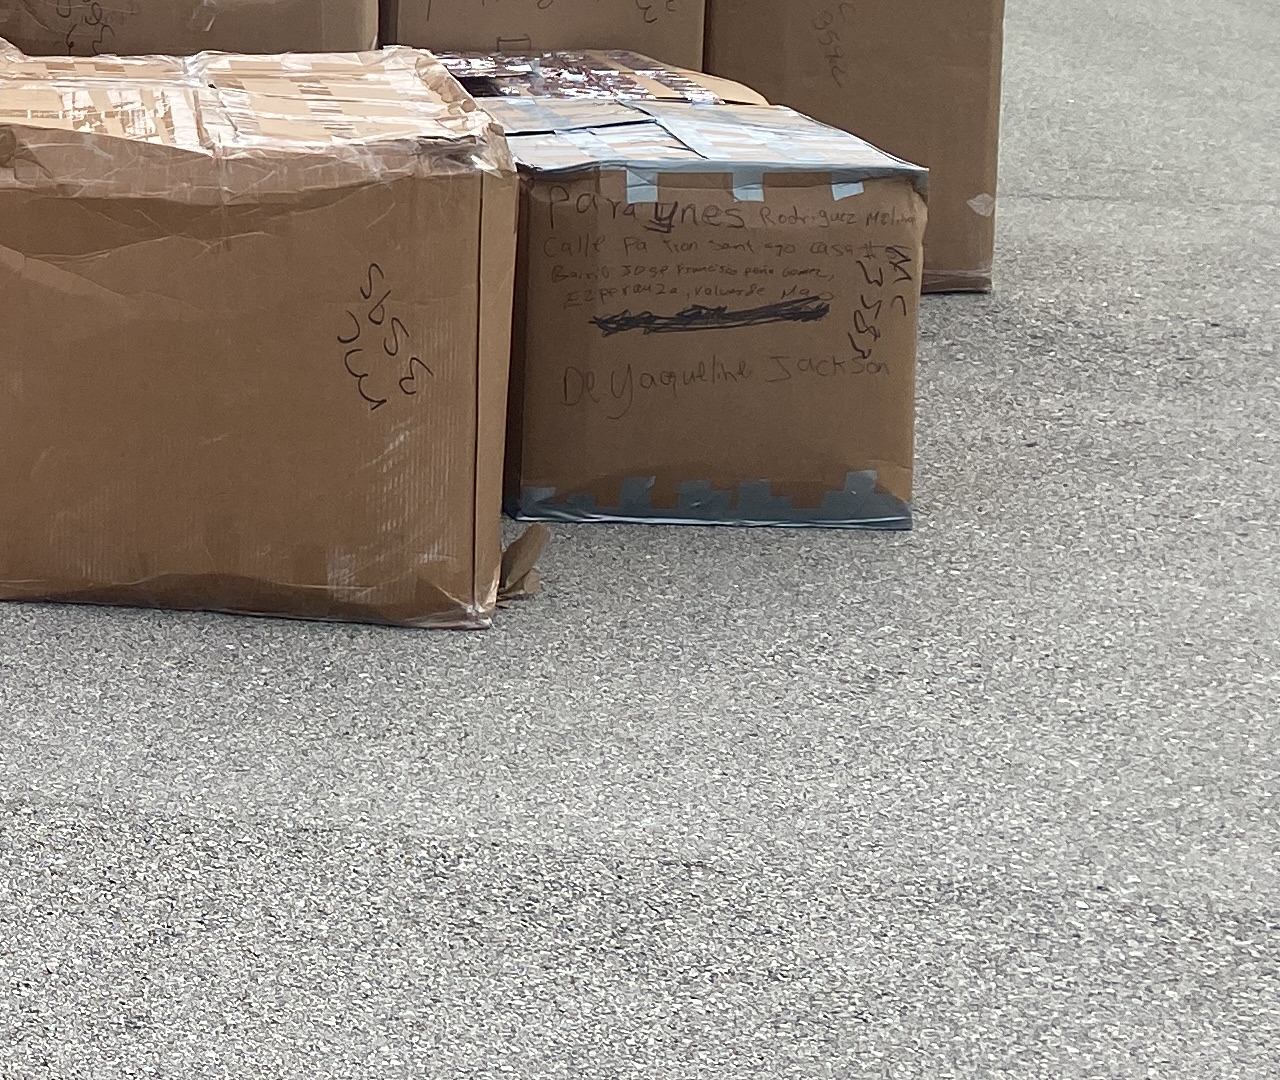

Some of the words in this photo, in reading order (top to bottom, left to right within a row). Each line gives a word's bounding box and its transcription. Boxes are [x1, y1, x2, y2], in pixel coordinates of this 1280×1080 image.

[549, 185, 636, 229] Para
[544, 234, 606, 258] Calle
[360, 263, 434, 395] 3595
